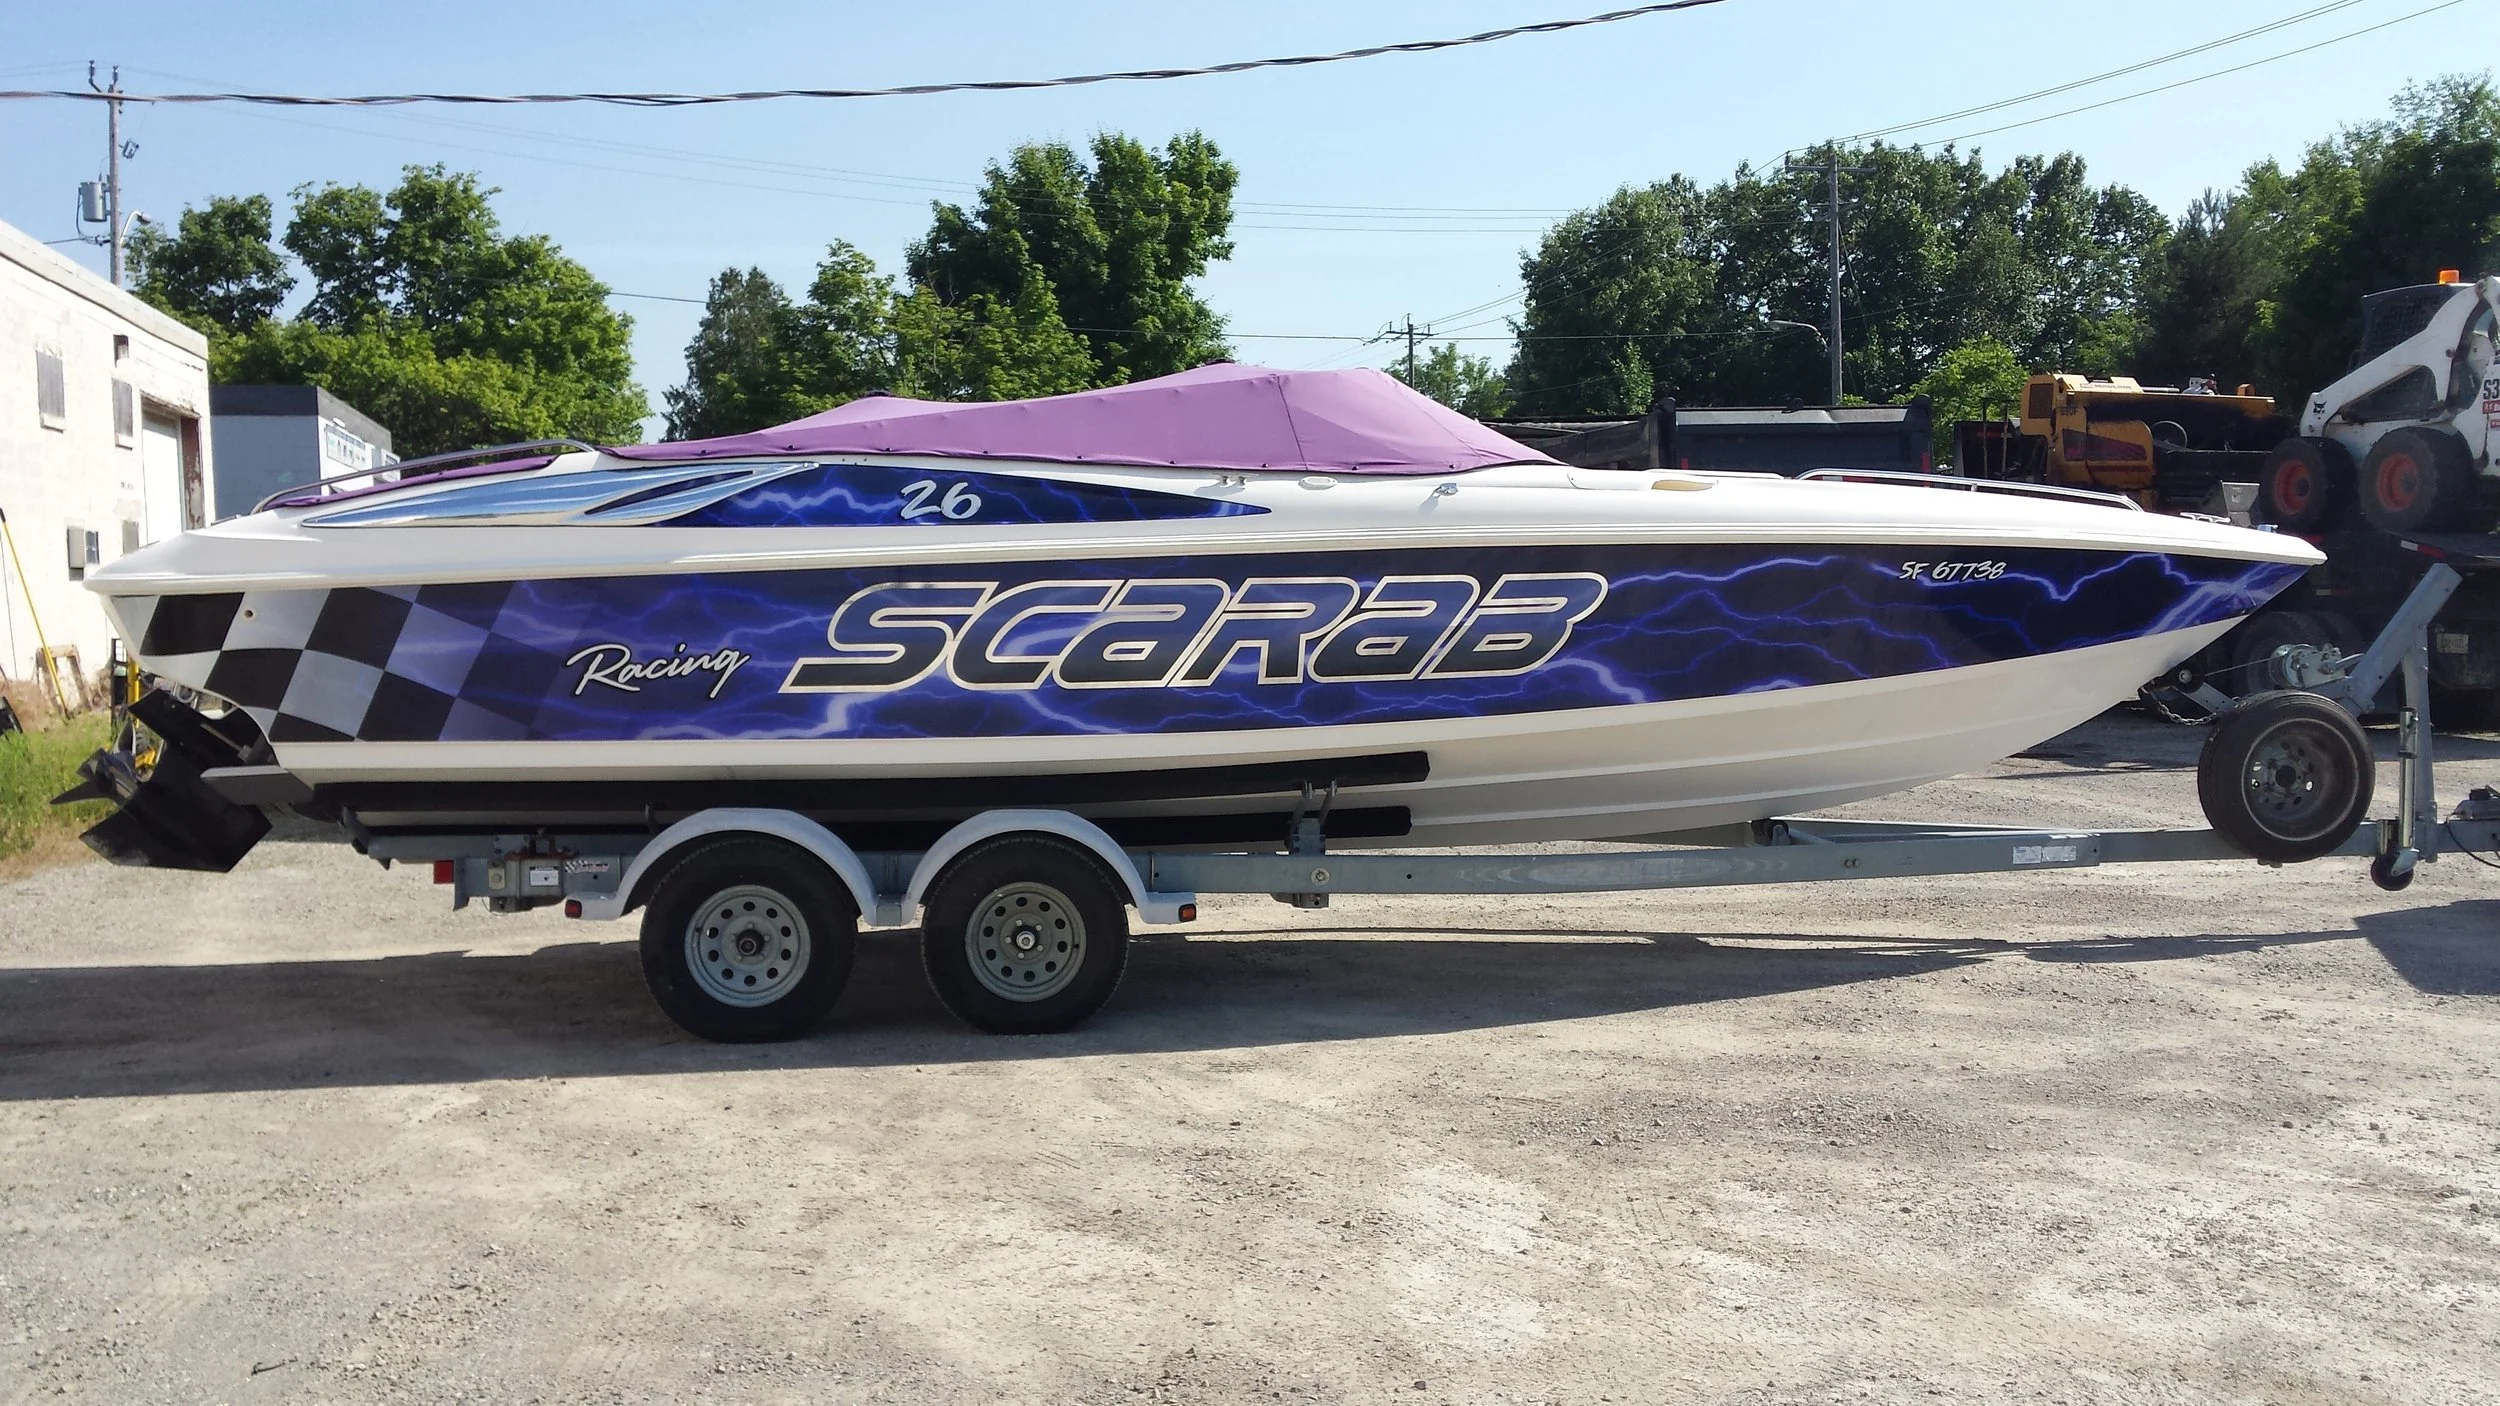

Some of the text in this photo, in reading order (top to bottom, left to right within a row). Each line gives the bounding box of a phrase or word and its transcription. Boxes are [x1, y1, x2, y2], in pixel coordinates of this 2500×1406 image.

[900, 479, 982, 520] 26
[1932, 560, 2007, 581] 67738
[566, 642, 750, 699] Racing
